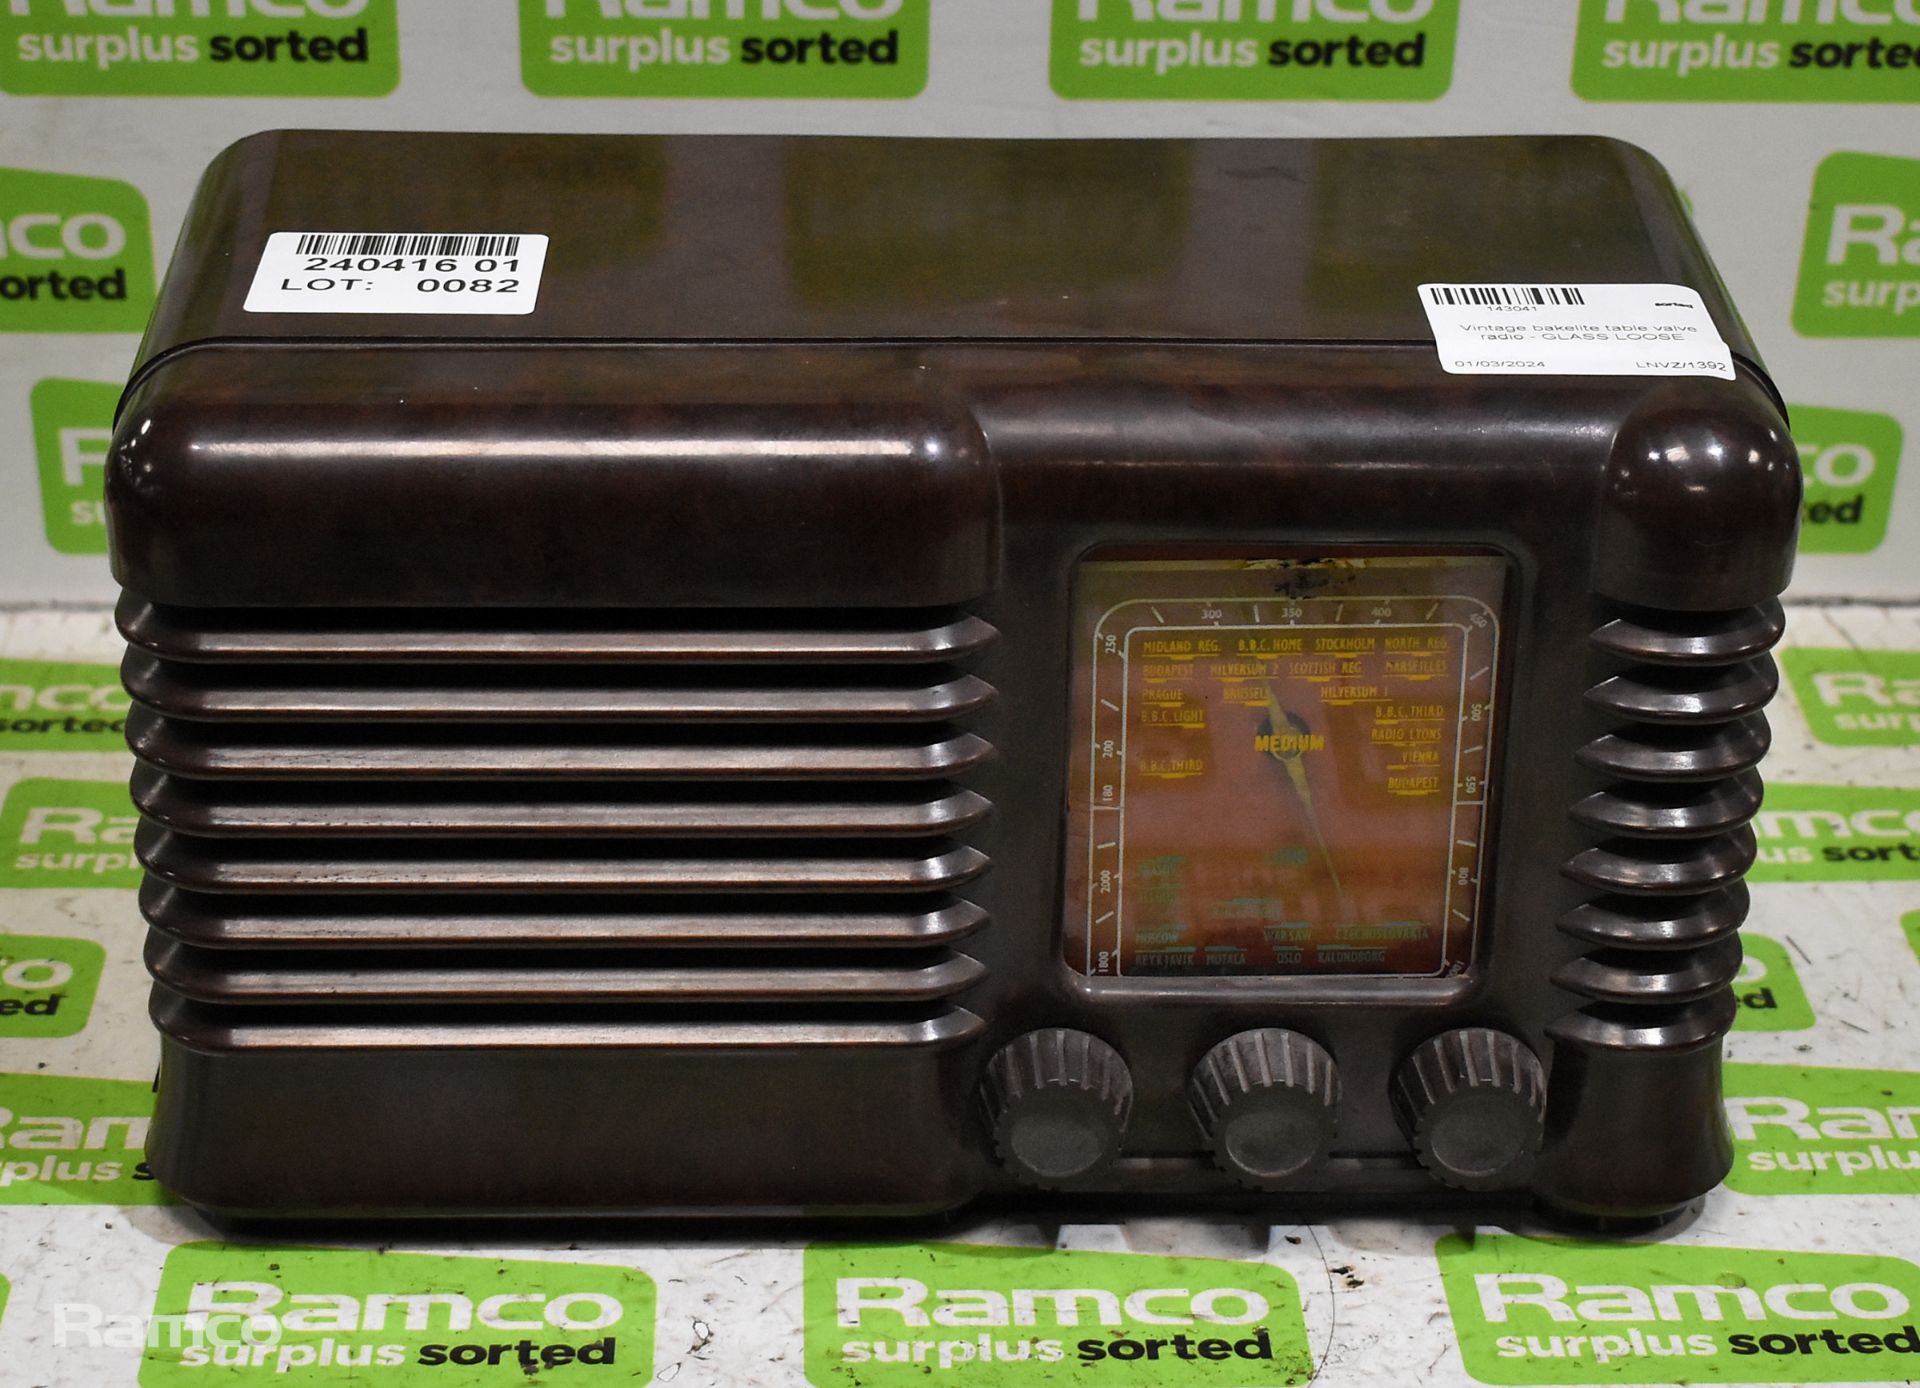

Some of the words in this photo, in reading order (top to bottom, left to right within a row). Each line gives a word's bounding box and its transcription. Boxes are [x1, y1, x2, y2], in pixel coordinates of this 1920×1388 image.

[18, 25, 199, 71] surplus
[209, 27, 368, 62] sorted
[550, 28, 730, 73] surplus
[740, 29, 898, 65] sorted
[1079, 30, 1258, 76] surplus
[1268, 32, 1425, 68] sorted
[1601, 32, 1781, 77] surplus
[1788, 36, 1920, 69] sorte
[303, 257, 458, 273] 240416
[474, 258, 519, 273] 01
[0, 267, 127, 301] orted
[281, 279, 374, 292] LOT:
[416, 278, 519, 293] 0082
[1822, 280, 1920, 316] surp
[1487, 305, 1538, 313] 143041
[1459, 323, 1526, 334] Vintage
[1532, 323, 1600, 333] bakelite
[1605, 324, 1648, 333] table
[1652, 325, 1698, 333] valve
[1480, 333, 1524, 341] radio
[1542, 333, 1609, 341] GLASS
[1615, 333, 1686, 341] LOOSE
[1454, 360, 1546, 369] 01/03/2024
[1201, 608, 1222, 619] 300
[1281, 607, 1303, 618] 350
[1371, 607, 1392, 618] 400
[1104, 634, 1117, 654] 250
[1143, 640, 1191, 653] MIDLAND
[1273, 638, 1303, 651] HOME
[1315, 638, 1375, 651] STOCKHOLM
[1471, 703, 1482, 722] 500
[0, 717, 124, 734] orte
[1371, 729, 1404, 741] RADIO
[1102, 739, 1114, 758] 200
[1102, 784, 1113, 802] 180
[1821, 842, 1920, 862] sort
[16, 852, 139, 874] surpl
[1100, 869, 1112, 895] 2000
[1747, 1145, 1920, 1176] surplu
[0, 1155, 123, 1187] plus
[183, 1281, 623, 1333] Ramco
[835, 1277, 1270, 1328] Ramco
[1473, 1273, 1910, 1322] Ramco
[841, 1333, 1064, 1369] surplus
[1077, 1330, 1273, 1361] sorted
[1497, 1328, 1718, 1363] surplus
[1730, 1325, 1920, 1355] sorted
[178, 1338, 406, 1374] surplus
[417, 1337, 616, 1367] sorted
